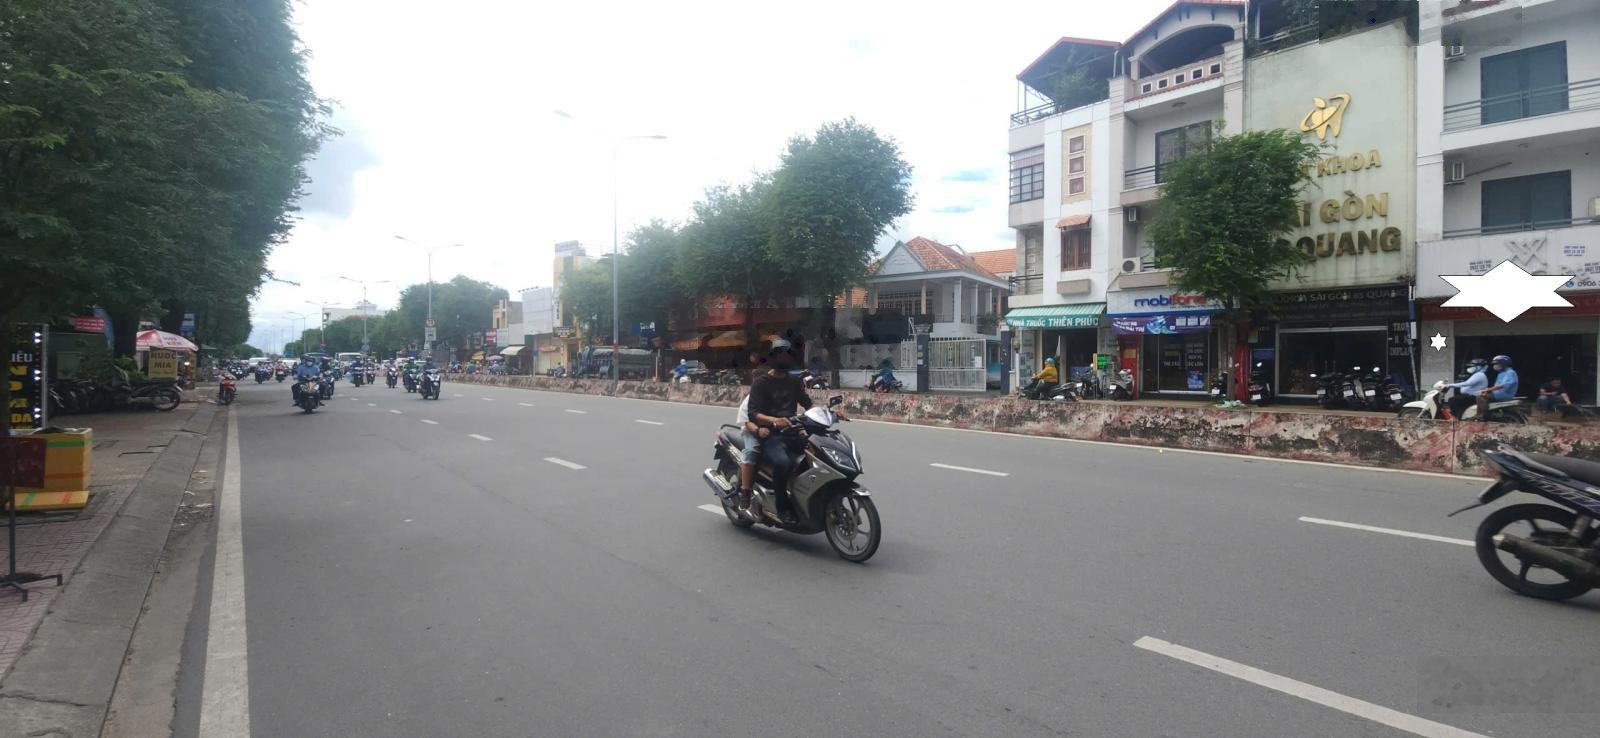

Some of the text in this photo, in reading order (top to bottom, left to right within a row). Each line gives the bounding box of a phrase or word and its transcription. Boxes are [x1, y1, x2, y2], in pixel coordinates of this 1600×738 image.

[1317, 149, 1382, 178] KHOA
[1319, 190, 1389, 224] GÒN
[1296, 226, 1402, 262] QUANG
[1048, 316, 1073, 327] THIÊN
[1075, 315, 1098, 326] PHÚC
